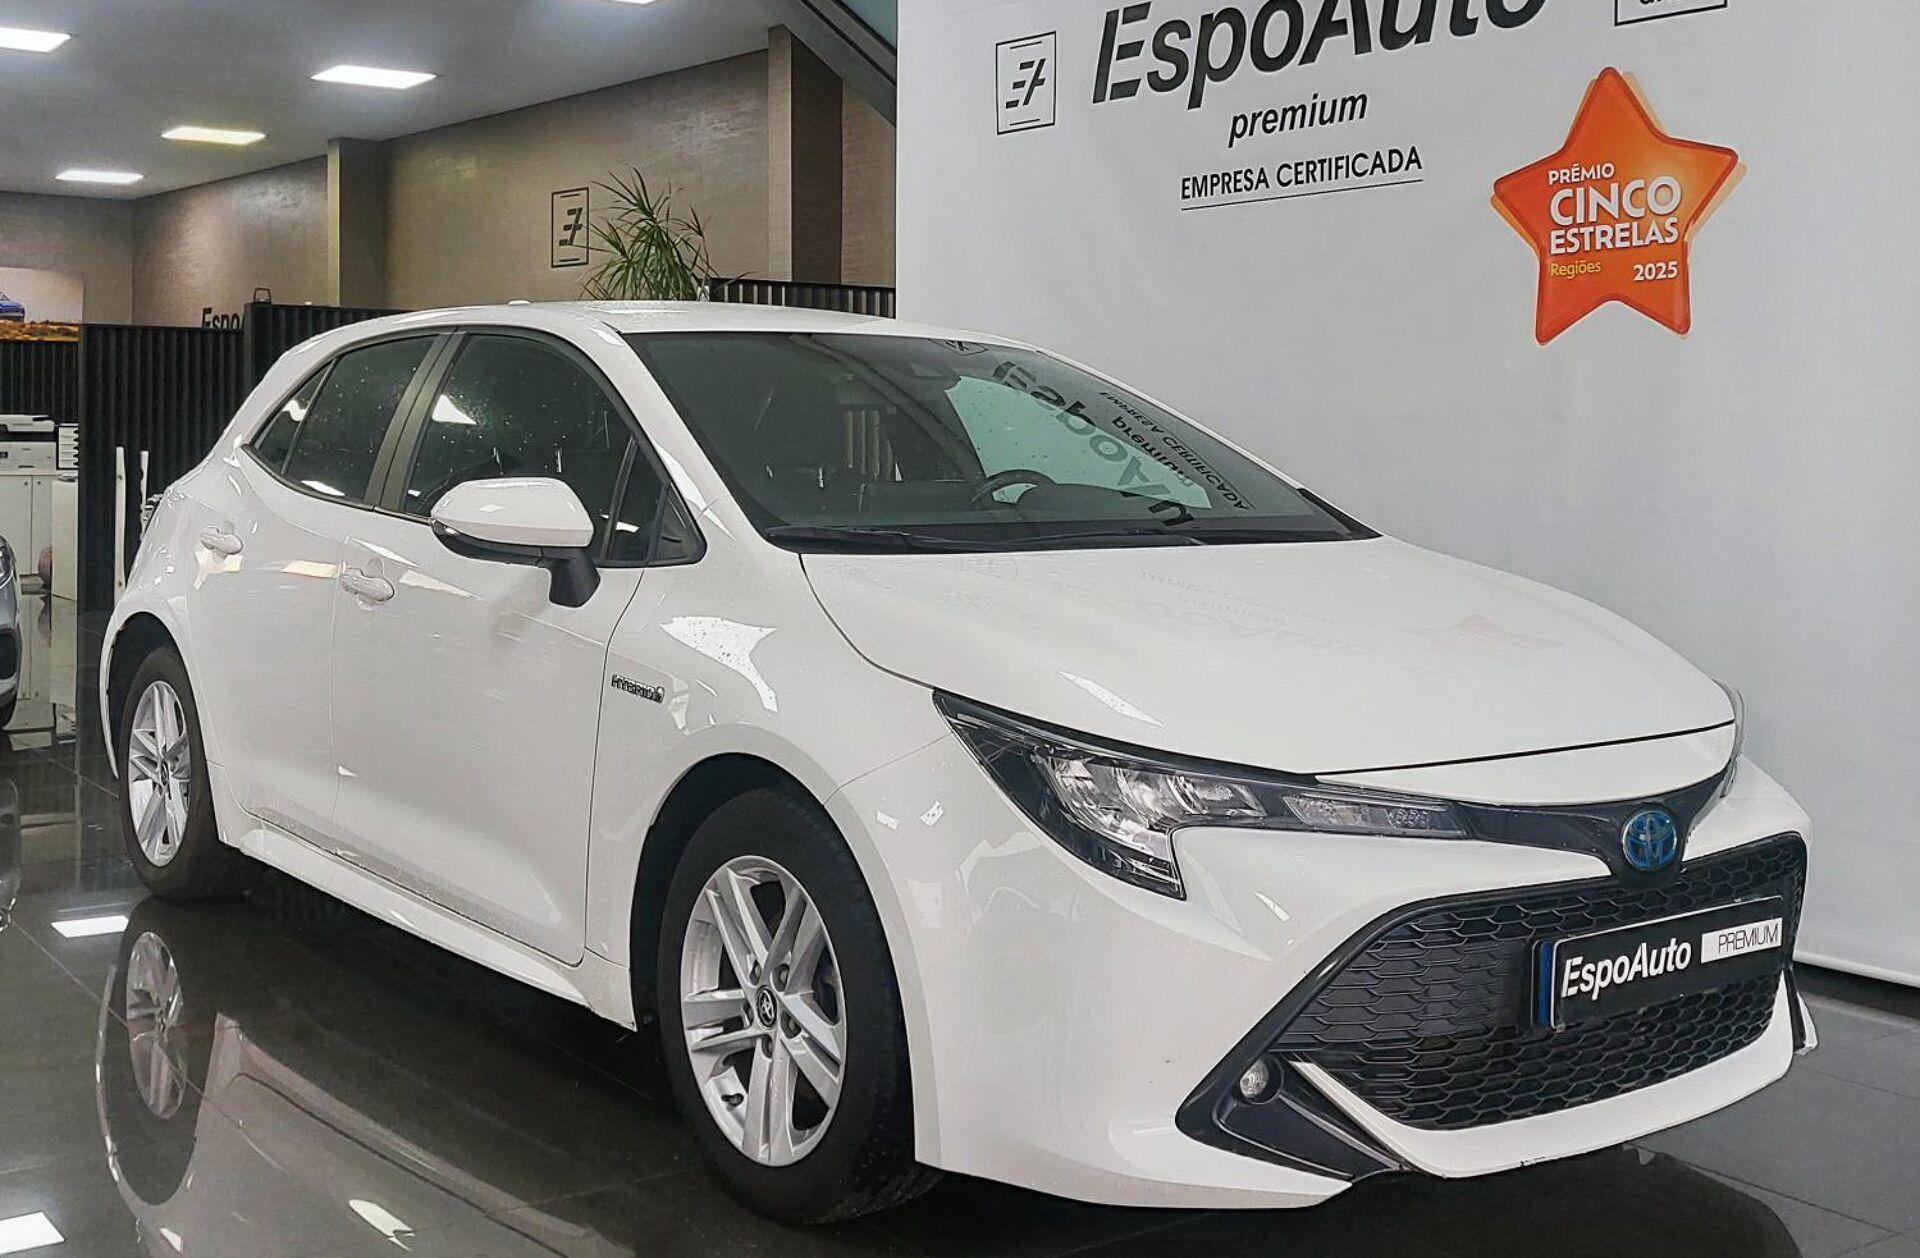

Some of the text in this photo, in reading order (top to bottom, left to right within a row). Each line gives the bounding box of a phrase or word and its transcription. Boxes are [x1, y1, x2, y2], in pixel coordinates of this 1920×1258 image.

[1228, 92, 1368, 149] premium
[1180, 146, 1423, 201] EMPRESA CERTIFICADA
[1548, 162, 1615, 186] PRÉMIO
[1550, 175, 1682, 227] CINCO
[1550, 217, 1680, 255] ESTRELAS
[1550, 259, 1678, 282] Regiões 2025
[1560, 923, 1779, 1000] EspoAuto PREMIUM
